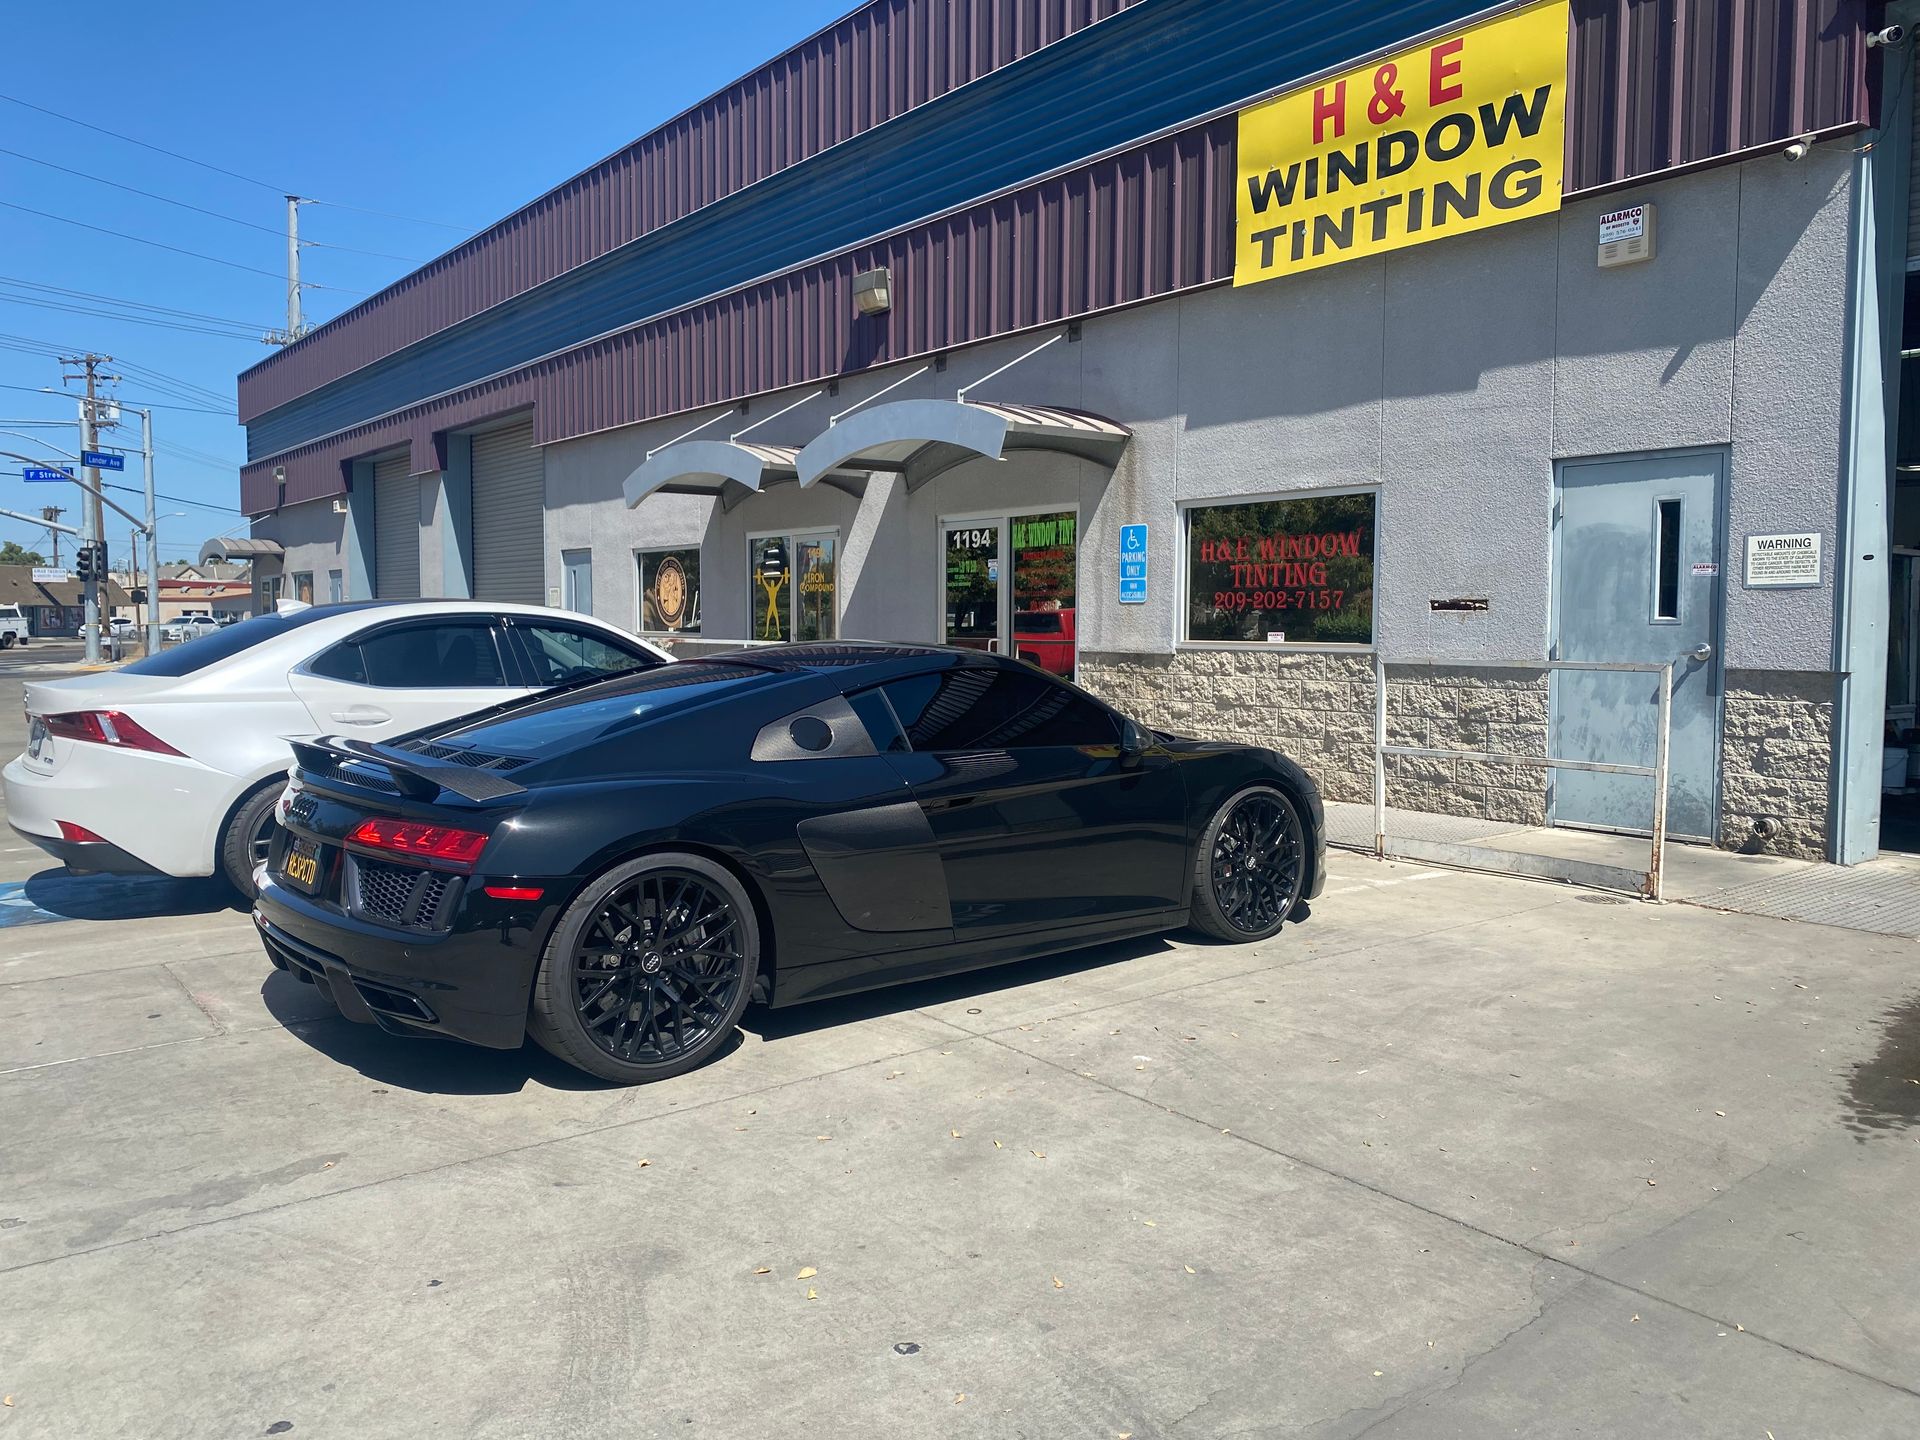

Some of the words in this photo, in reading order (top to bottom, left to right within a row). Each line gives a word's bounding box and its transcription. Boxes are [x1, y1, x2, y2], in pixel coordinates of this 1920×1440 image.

[1312, 80, 1346, 145] H
[1367, 63, 1406, 125] &
[1429, 37, 1464, 108] E
[1247, 83, 1552, 215] WINDOW
[1250, 158, 1543, 269] TINTING
[1600, 208, 1642, 225] ALARMCO
[110, 458, 120, 466] Ave
[954, 529, 990, 549] 1194
[1028, 521, 1056, 547] WINDOW
[1059, 519, 1074, 544] TINT
[1201, 538, 1250, 562] H&E
[1258, 526, 1363, 560] WINDOW
[1757, 538, 1811, 549] WARNING
[1122, 552, 1145, 562] PARKING
[808, 572, 824, 583] IRON
[1127, 565, 1140, 576] ONLY
[1230, 562, 1328, 588] TINTING
[800, 583, 834, 593] COMPOUND
[1214, 590, 1344, 612] 209-202-7157
